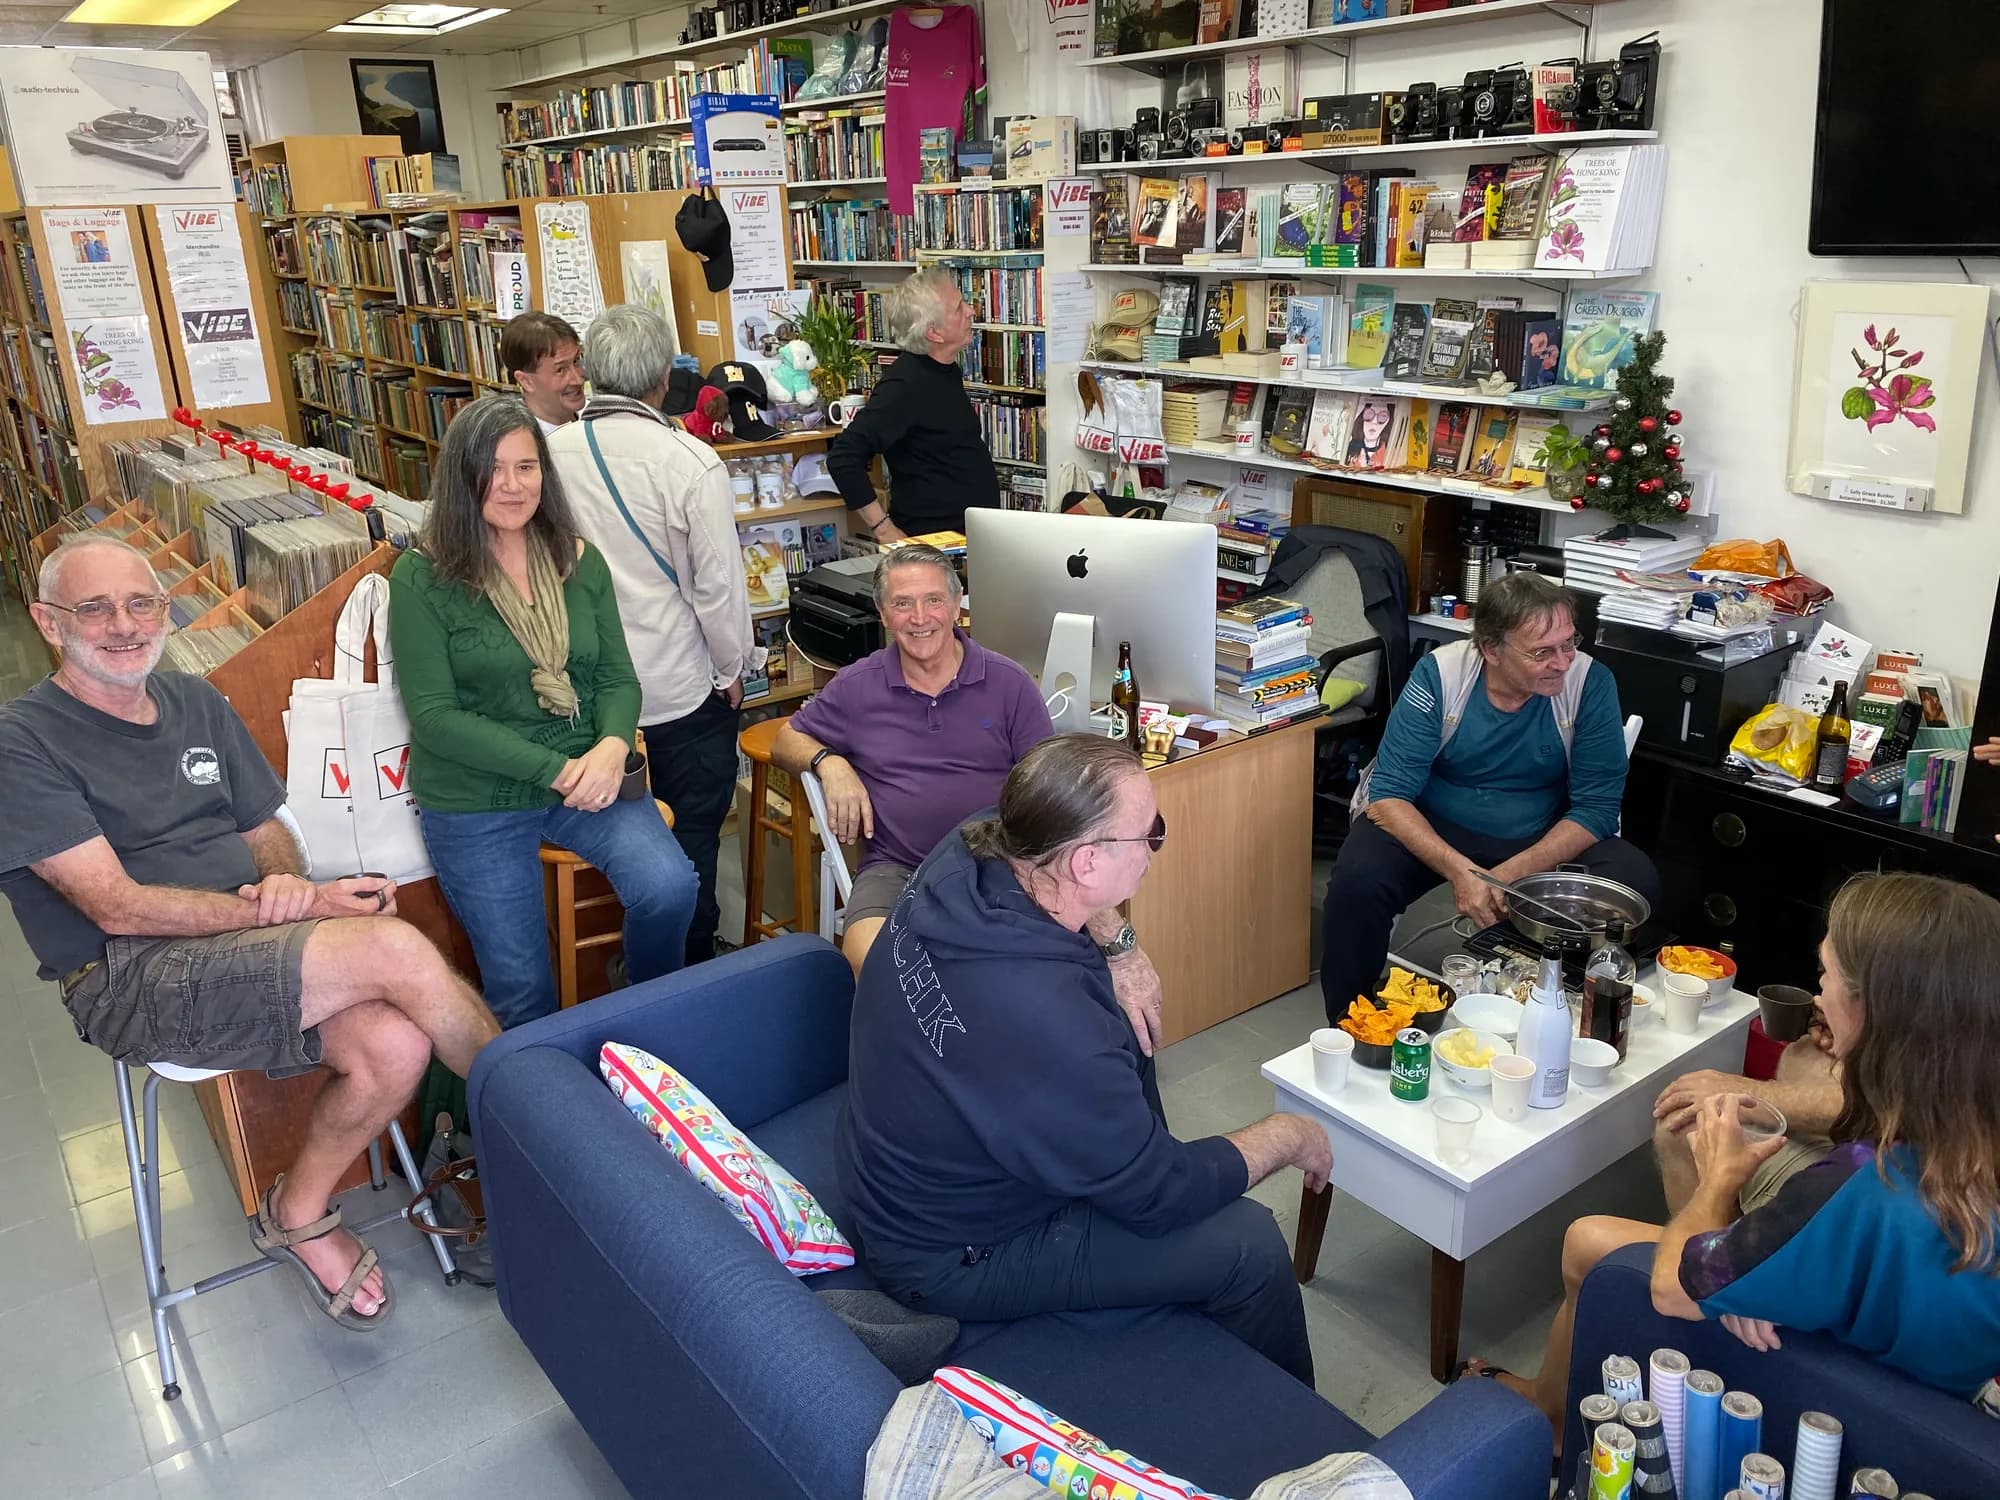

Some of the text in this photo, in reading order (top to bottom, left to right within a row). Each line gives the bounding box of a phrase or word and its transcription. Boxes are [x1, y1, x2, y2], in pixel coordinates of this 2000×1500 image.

[776, 42, 802, 52] PASTA
[20, 84, 79, 94] audio-technica
[1228, 87, 1281, 108] FASHION
[1576, 168, 1620, 176] HONG KONG
[1409, 200, 1423, 214] 42
[48, 218, 70, 227] Bags
[84, 218, 120, 226] Luggage
[511, 261, 523, 310] PROUD
[1575, 303, 1646, 317] GREEN DRAGON
[1281, 356, 1296, 366] BE
[1218, 552, 1235, 566] INE
[1884, 661, 1907, 669] LUXE
[1874, 681, 1898, 691] LUXE
[1863, 705, 1888, 715] LUXE
[1392, 1059, 1428, 1079] lsberg
